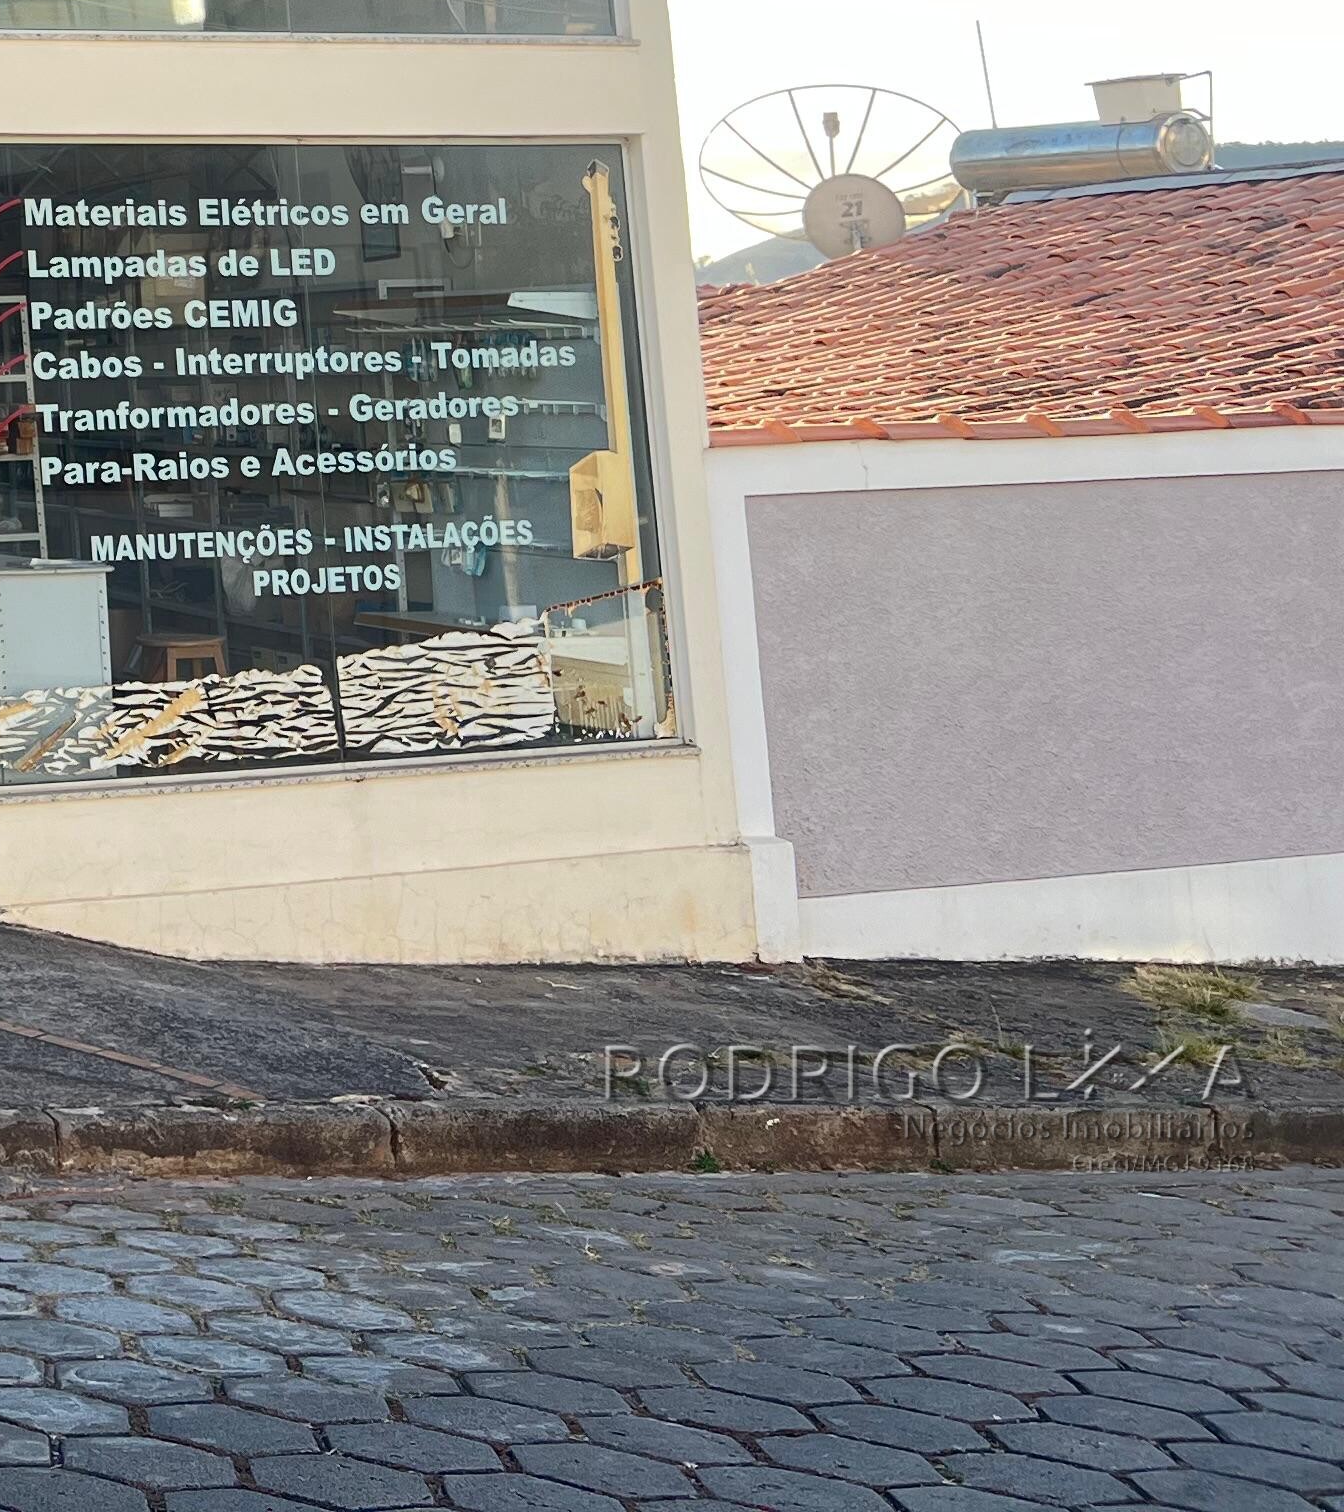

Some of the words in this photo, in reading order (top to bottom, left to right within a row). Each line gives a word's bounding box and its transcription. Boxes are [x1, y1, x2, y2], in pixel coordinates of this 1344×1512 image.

[24, 198, 187, 227] Materiais
[198, 196, 349, 227] Elétricos
[360, 202, 409, 226] em
[421, 196, 508, 225] Geral
[27, 250, 206, 285] Lampadas
[217, 249, 259, 277] de
[270, 247, 336, 276] LED
[30, 300, 173, 330] Padrões
[183, 298, 298, 330] CEMIG
[33, 351, 143, 381] Cabos
[176, 347, 403, 381] Interruptores
[430, 340, 576, 371] Tomadas
[36, 400, 315, 433] Tranformadores
[349, 391, 519, 422] Geradores
[41, 453, 230, 486] Para-Raios
[240, 455, 261, 478] e
[272, 444, 457, 476] Acessórios
[90, 526, 312, 563] MANUTENÇÕES
[344, 516, 533, 552] INSTALAÇÕES
[253, 563, 402, 597] PROJETOS
